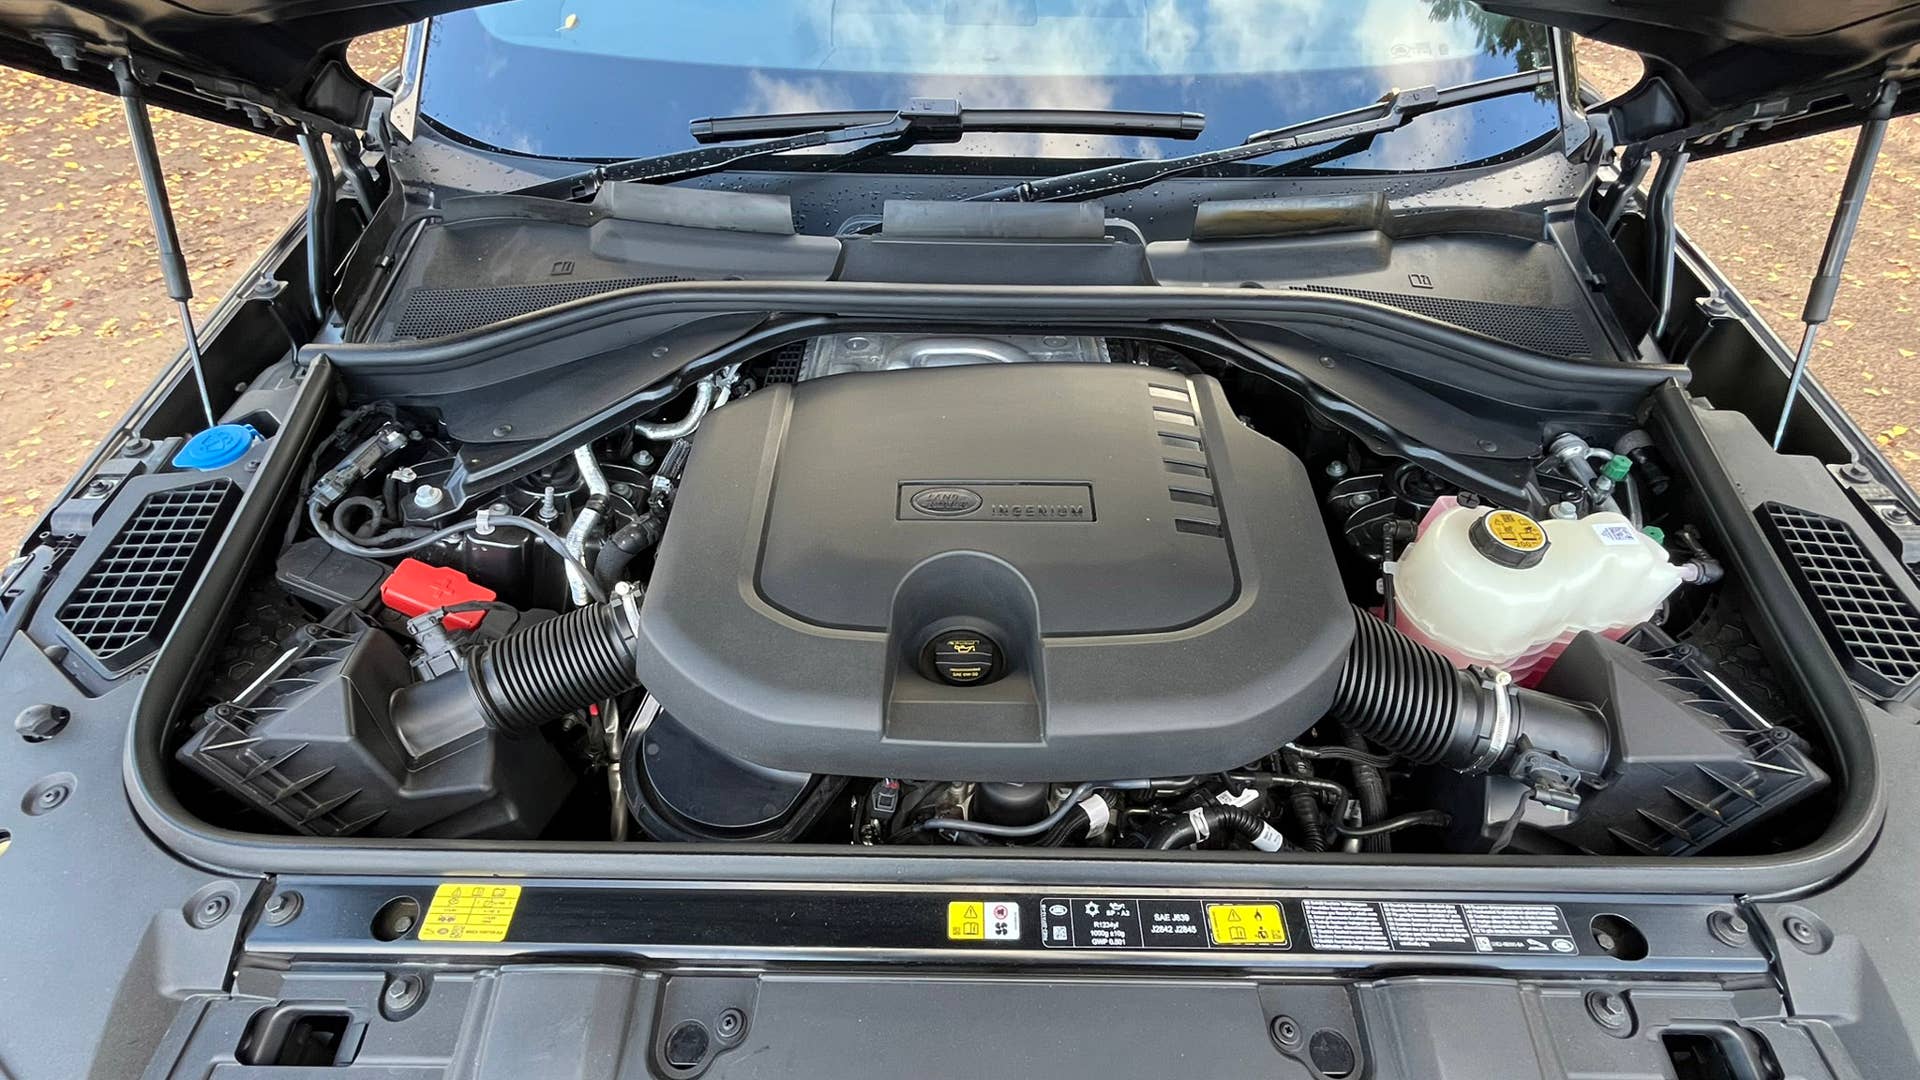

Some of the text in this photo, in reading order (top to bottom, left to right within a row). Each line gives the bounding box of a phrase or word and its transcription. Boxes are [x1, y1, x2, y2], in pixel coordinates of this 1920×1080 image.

[990, 504, 1085, 518] INGENIUM
[1153, 912, 1191, 922] SAE J639
[1151, 924, 1198, 934] J2842 J2845
[1091, 938, 1109, 946] GWP
